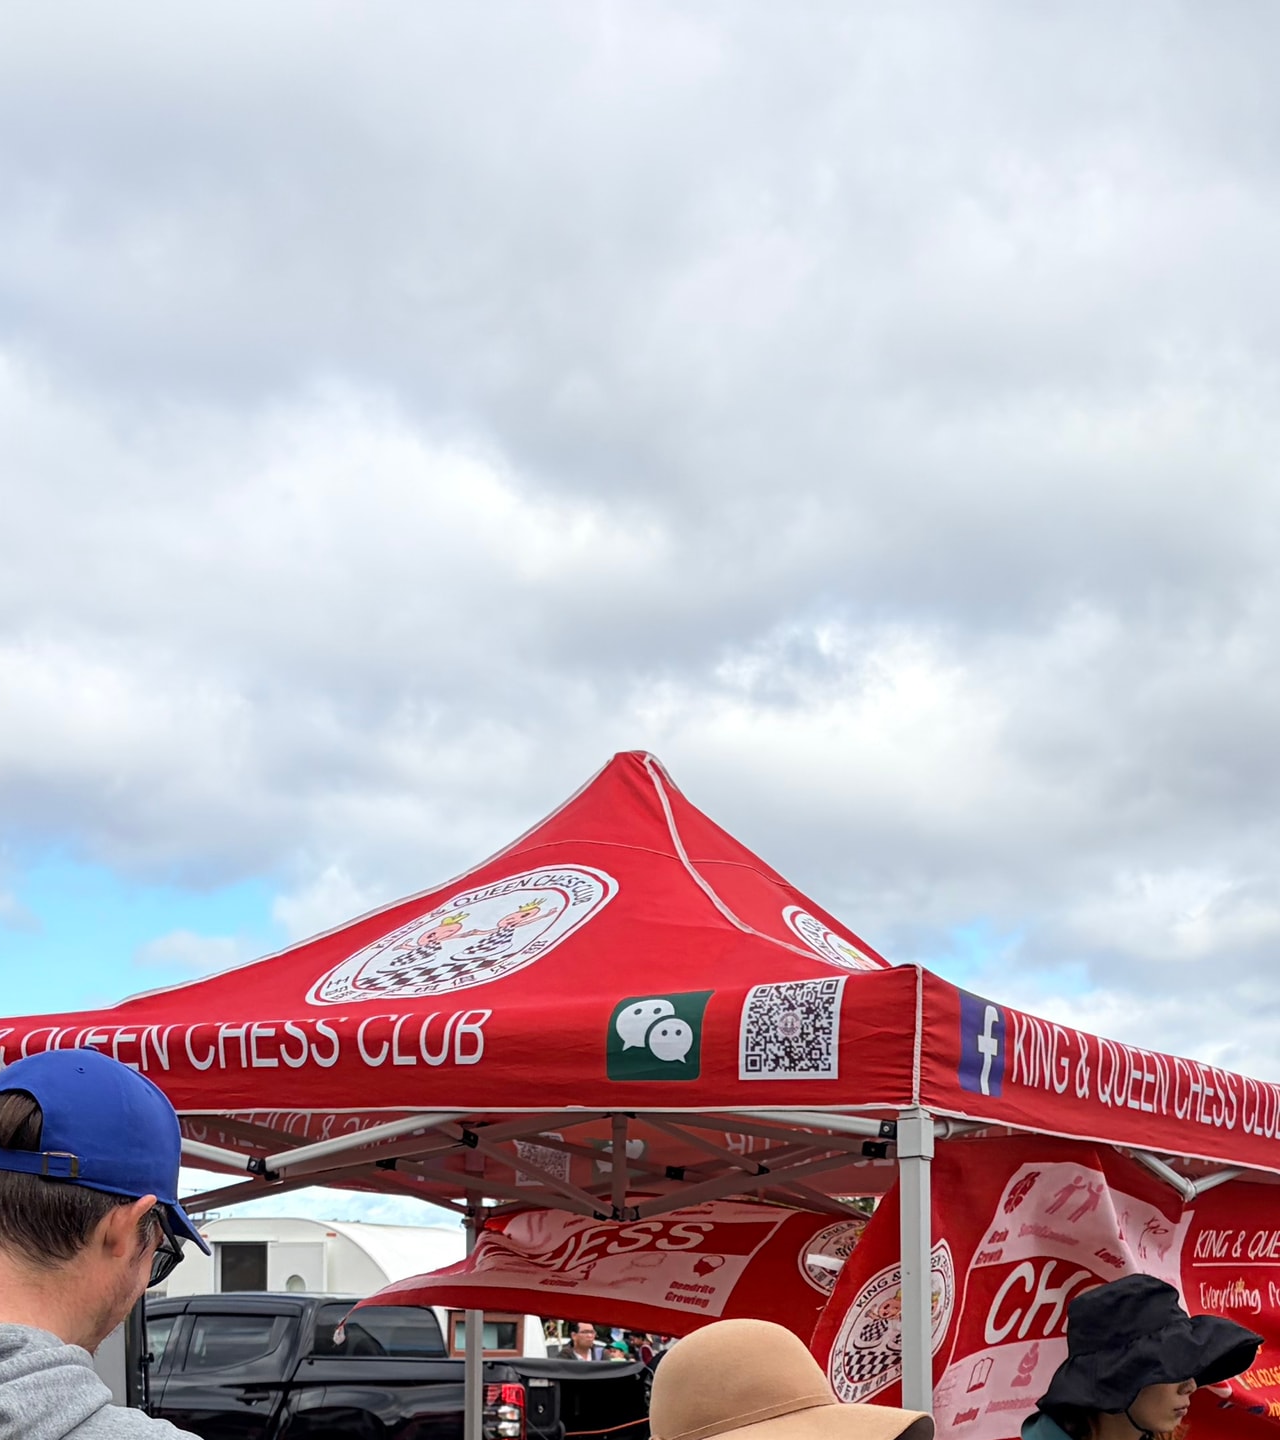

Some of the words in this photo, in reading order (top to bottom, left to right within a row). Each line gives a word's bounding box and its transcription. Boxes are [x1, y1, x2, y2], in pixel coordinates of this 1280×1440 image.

[453, 877, 533, 908] QUEEN
[184, 1016, 349, 1071] CHESS
[357, 1008, 493, 1068] CLUB
[1011, 1011, 1070, 1094] KING
[1075, 1031, 1091, 1099] &
[1096, 1037, 1169, 1115] QUEEN
[1173, 1057, 1238, 1130] CHESS
[1194, 1230, 1232, 1258] KING
[1232, 1231, 1245, 1258] &
[665, 1291, 710, 1308] Growing
[856, 1277, 888, 1308] KING
[1199, 1280, 1262, 1315] Everything
